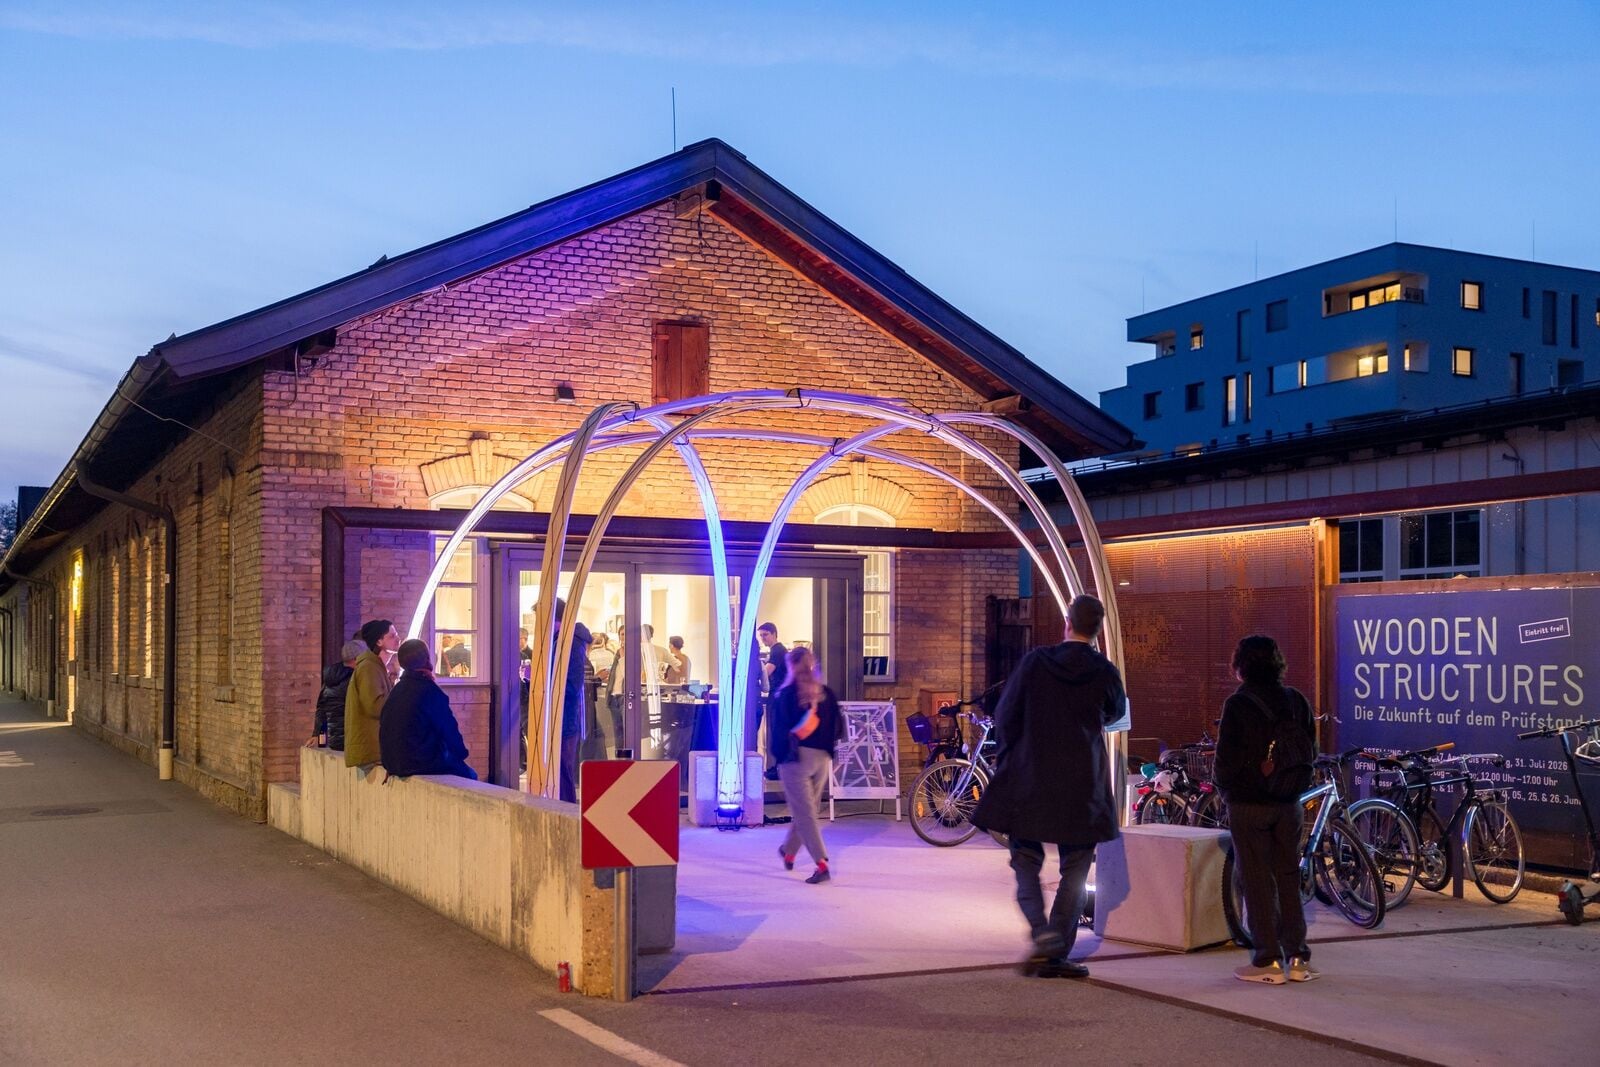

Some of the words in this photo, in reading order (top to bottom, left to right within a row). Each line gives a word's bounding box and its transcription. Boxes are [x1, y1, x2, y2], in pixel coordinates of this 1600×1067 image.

[1353, 616, 1497, 656] WOODEN
[1524, 626, 1549, 637] Eintritt
[1550, 624, 1564, 633] frei!
[1354, 662, 1584, 707] STRUCTURES
[1354, 705, 1374, 721] Die
[1378, 706, 1431, 724] Zukunft
[1437, 709, 1461, 725] auf
[1466, 710, 1496, 727] dem
[1515, 757, 1527, 768] 31.
[1529, 758, 1546, 769] Juli
[1548, 760, 1568, 771] 2026
[1543, 776, 1558, 787] Uhr
[1528, 791, 1540, 802] 25.
[1541, 793, 1548, 803] &
[1550, 794, 1562, 804] 26.
